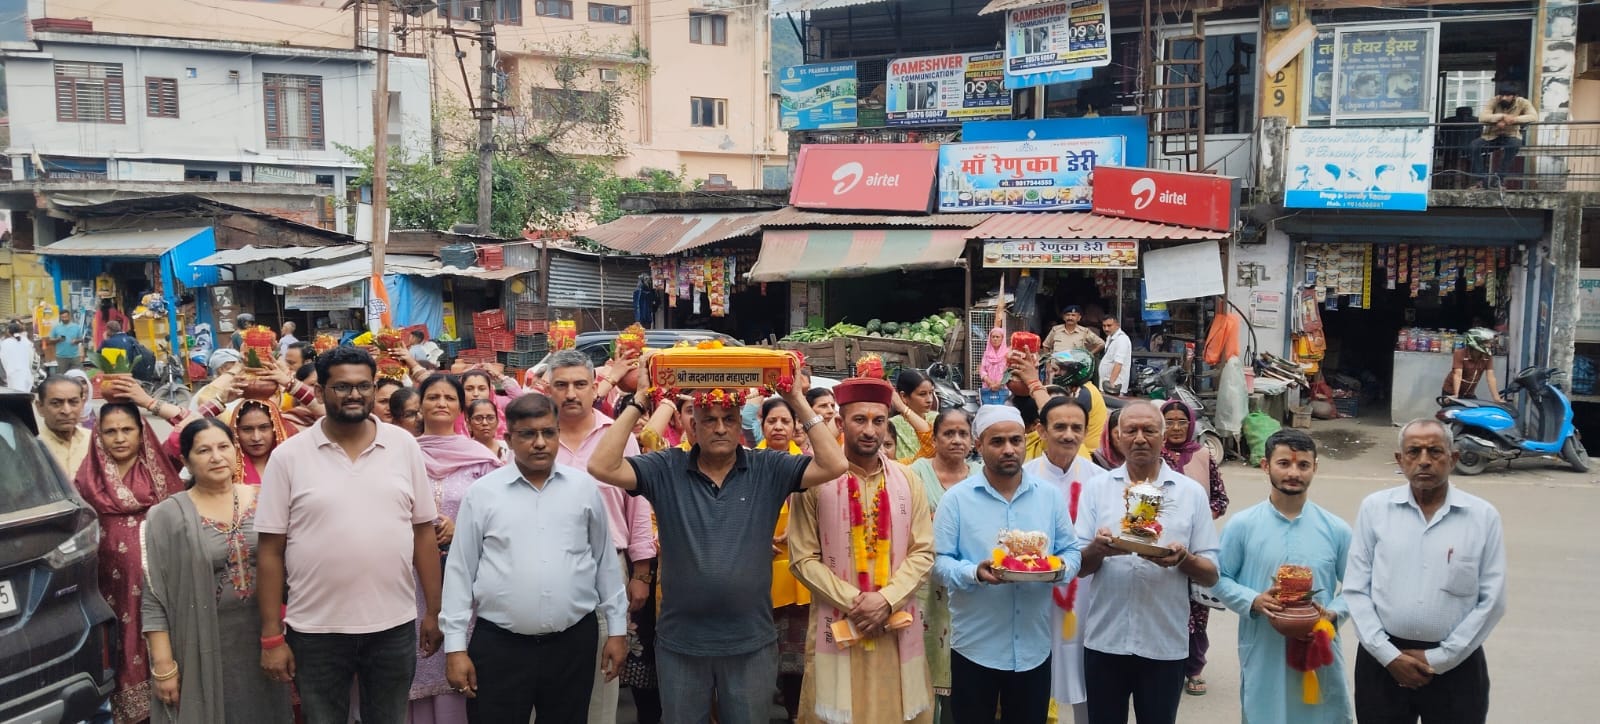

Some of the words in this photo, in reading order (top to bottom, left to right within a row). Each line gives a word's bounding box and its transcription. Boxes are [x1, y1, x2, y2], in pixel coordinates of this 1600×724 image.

[1012, 3, 1067, 23] RAMESHVER
[1019, 16, 1061, 28] COMMUNICATION
[892, 55, 963, 75] RAMESHVER
[901, 70, 955, 82] COMMUNICATION
[960, 153, 986, 175] माँ
[992, 154, 1060, 179] रेणुका
[1066, 149, 1098, 172] डेरी
[866, 172, 900, 187] airtel
[1159, 190, 1187, 205] airtel
[1018, 241, 1036, 251] माँ
[1040, 241, 1078, 253] रेणुका
[1083, 241, 1103, 252] डेरी
[677, 371, 687, 383] श्री
[726, 372, 759, 386] महापुराण
